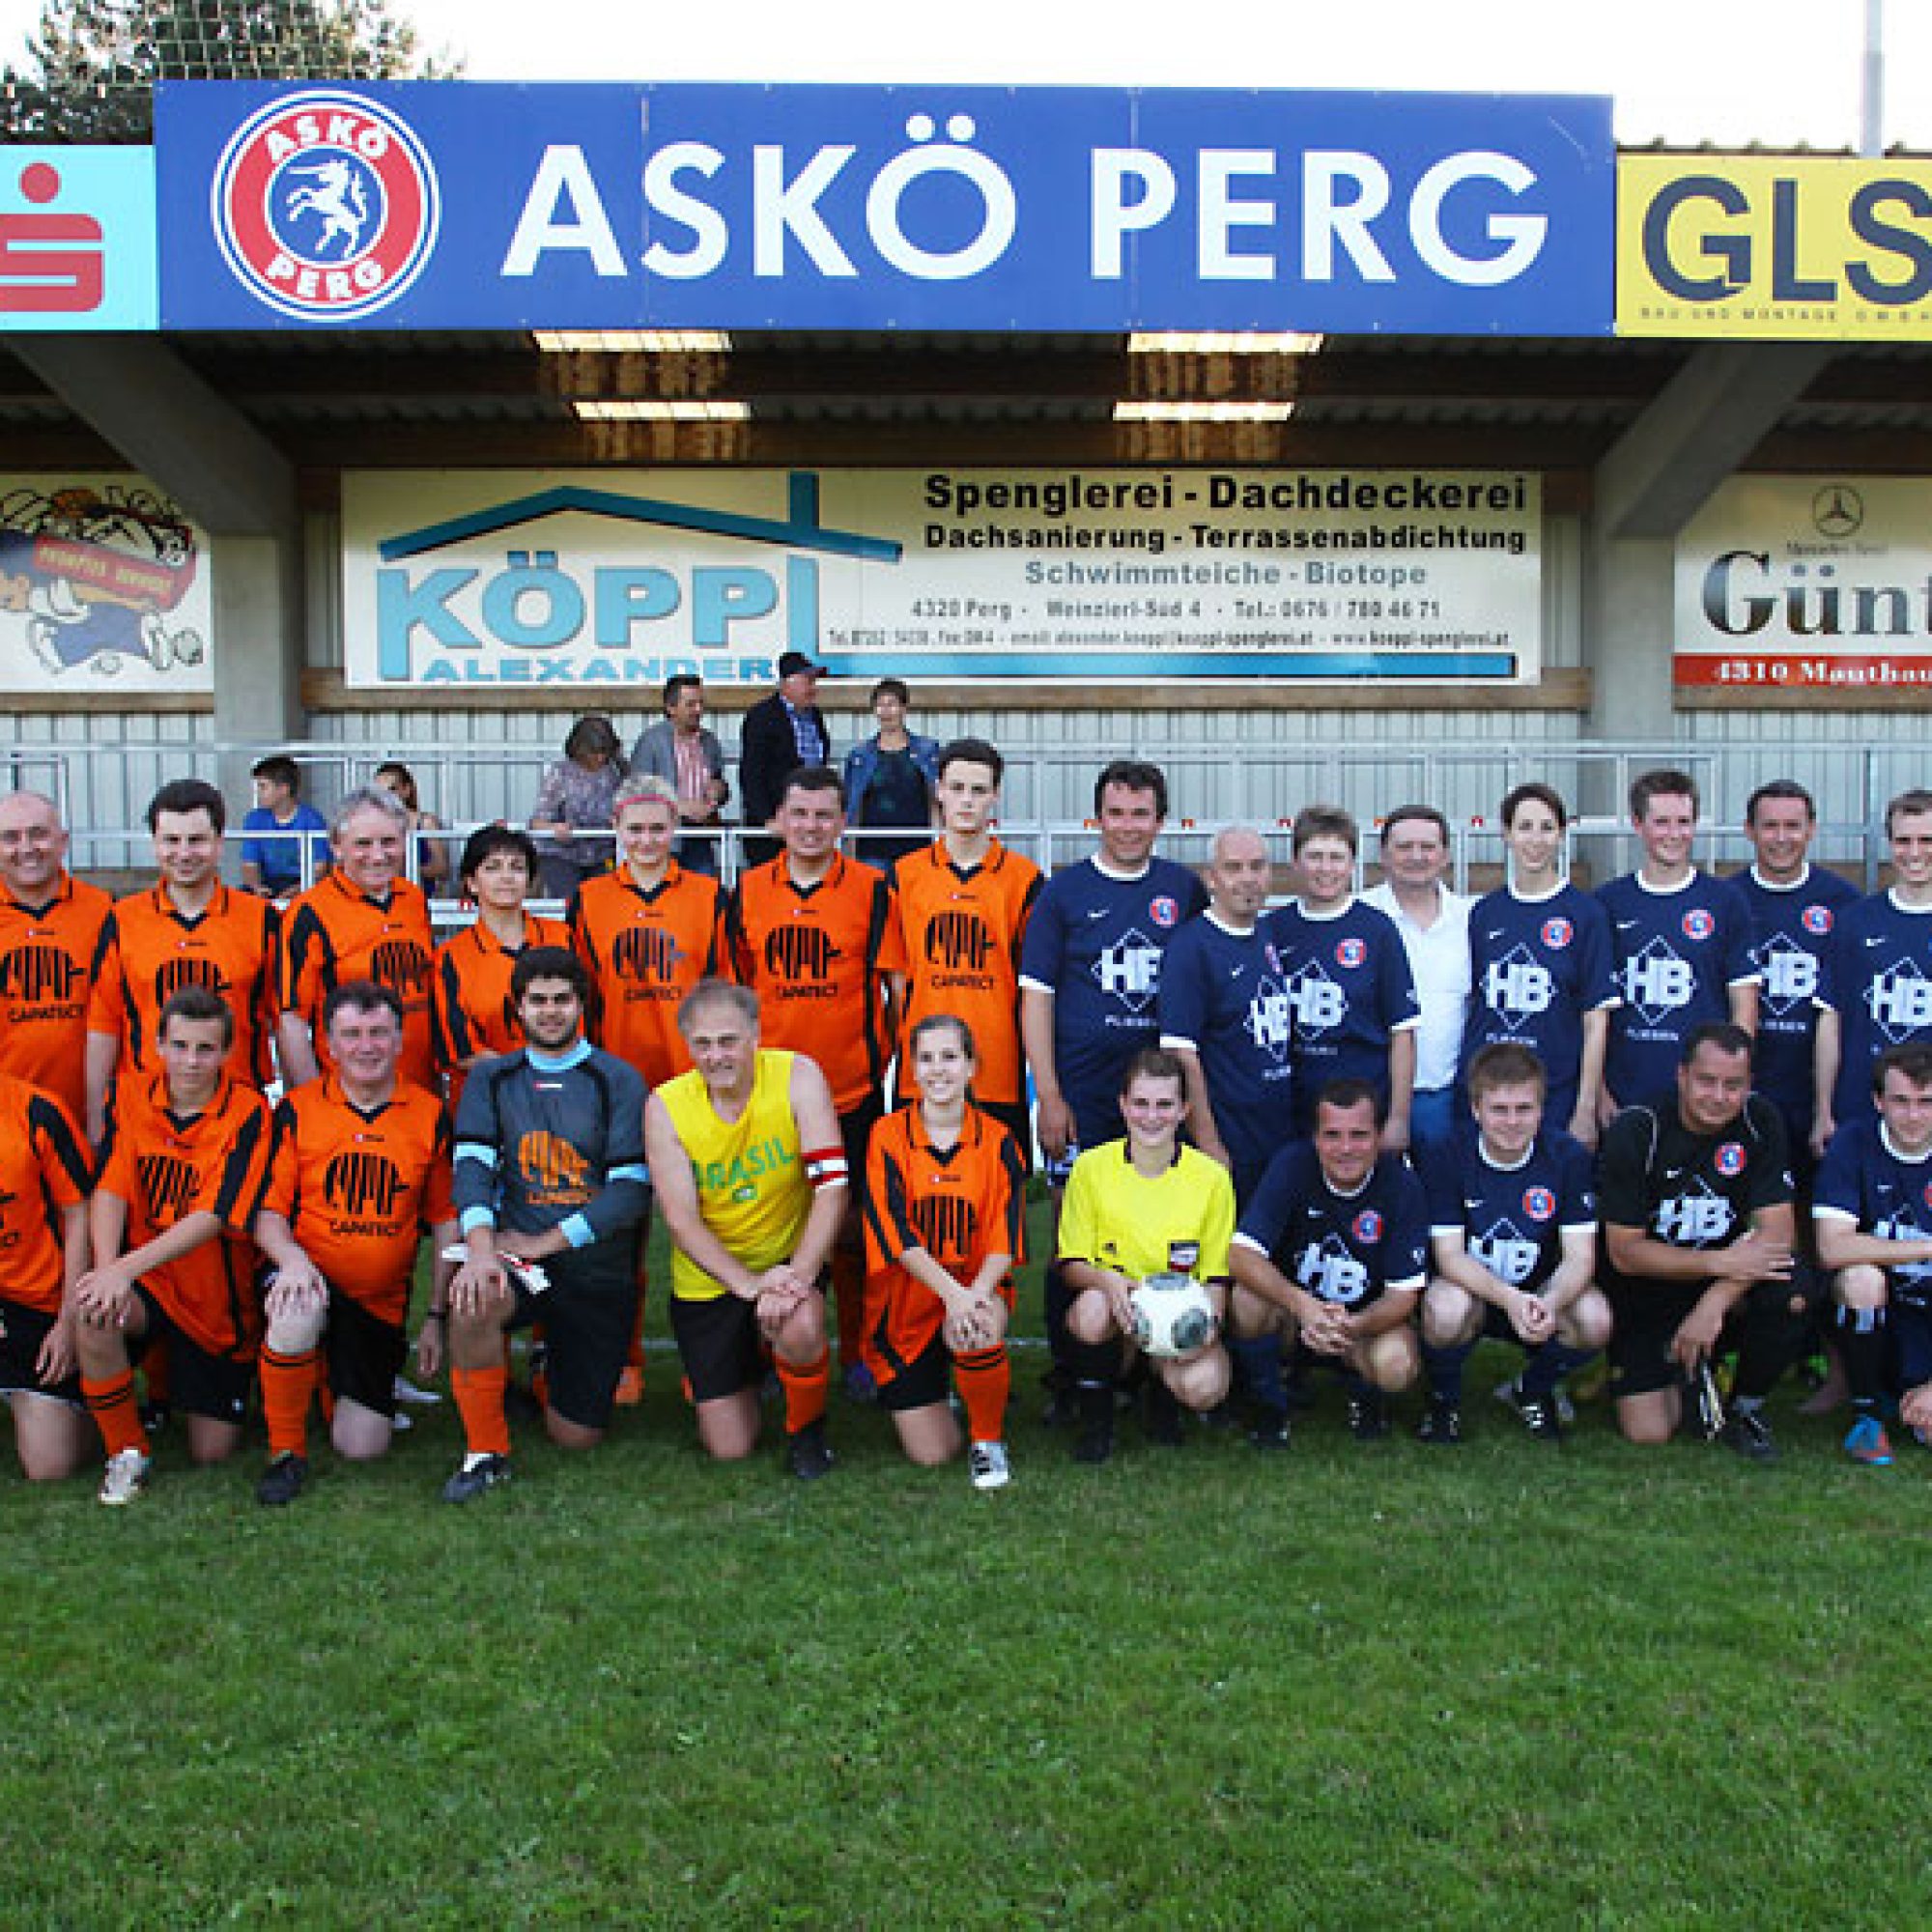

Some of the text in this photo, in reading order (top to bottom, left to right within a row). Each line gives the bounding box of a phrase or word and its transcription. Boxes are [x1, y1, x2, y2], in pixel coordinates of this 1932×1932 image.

[500, 113, 1548, 286] ASKÖ PERG
[1642, 174, 1932, 305] GLS
[265, 253, 384, 298] PERG
[923, 473, 1172, 518] Spenglerei
[1208, 473, 1526, 511] Dachdeckerei
[923, 522, 1164, 555] Dachsanierung
[1189, 524, 1526, 555] Terrassenabdichtung
[1025, 560, 1281, 584] Schwimmteiche
[1304, 561, 1428, 590] Biotope
[1701, 550, 1932, 636] Gün
[910, 599, 961, 618] 4320
[966, 599, 1012, 623] Perg
[1188, 599, 1202, 618] 4
[423, 657, 777, 682] ALEXANDER
[1486, 962, 1551, 1012] HB
[1627, 955, 1693, 1006] HB
[1871, 974, 1932, 1027] HB
[1657, 1198, 1730, 1241] HB
[1297, 1242, 1368, 1302] HB
